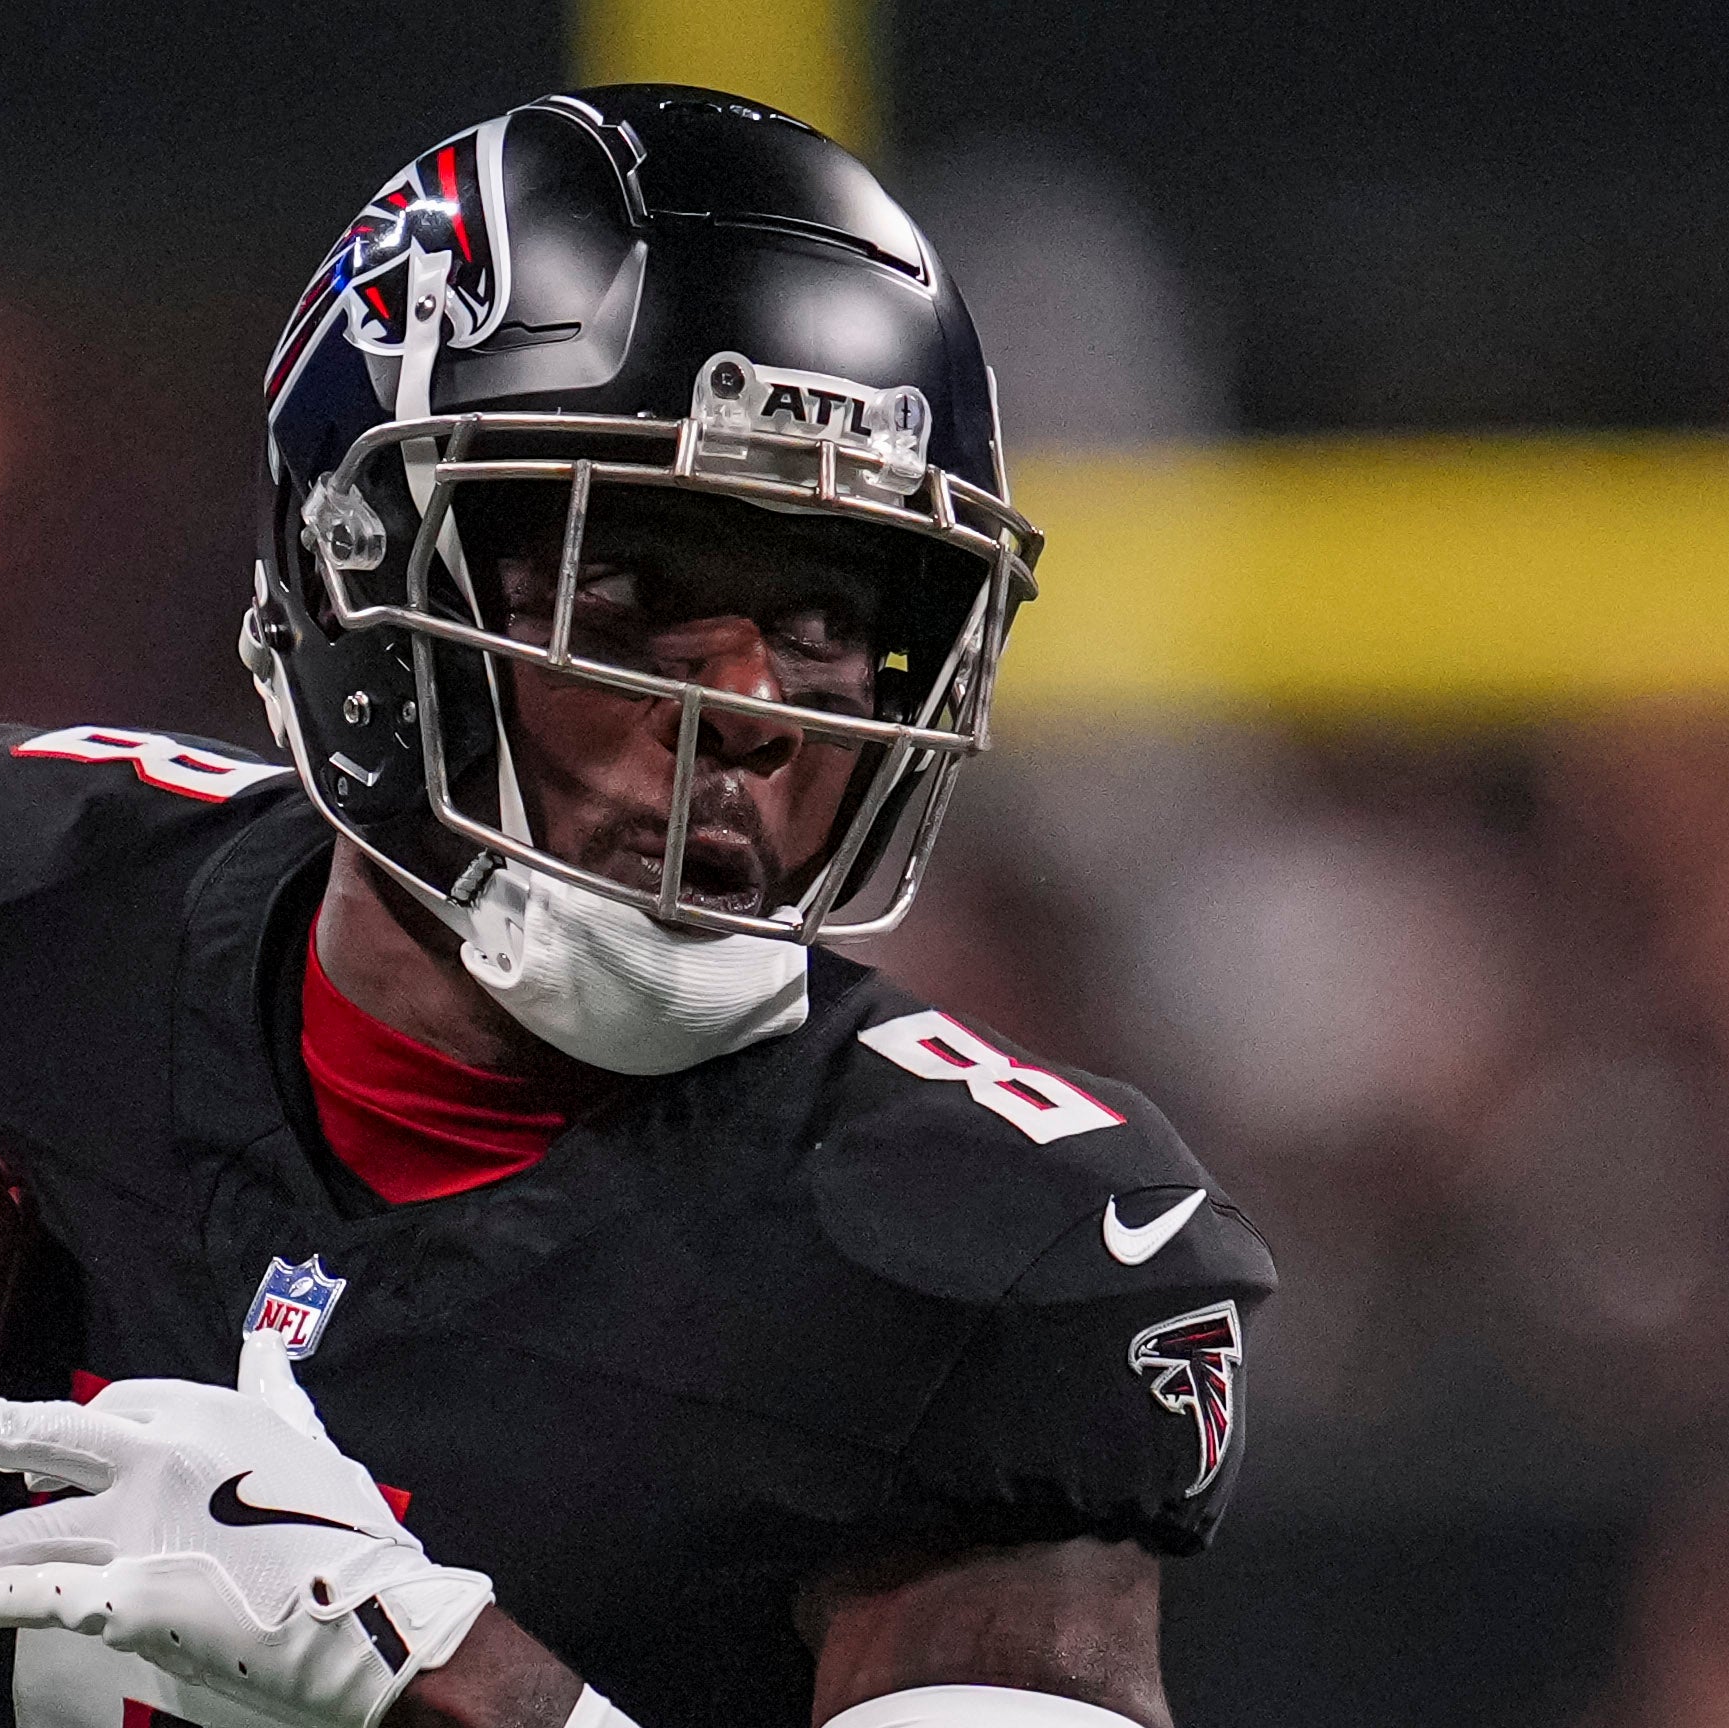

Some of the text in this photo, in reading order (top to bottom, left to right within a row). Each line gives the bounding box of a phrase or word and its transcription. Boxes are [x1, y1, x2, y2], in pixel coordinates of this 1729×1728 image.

[761, 383, 872, 437] ATL
[10, 724, 296, 804] 8
[857, 1009, 1127, 1145] 8
[258, 1300, 309, 1345] NFL
